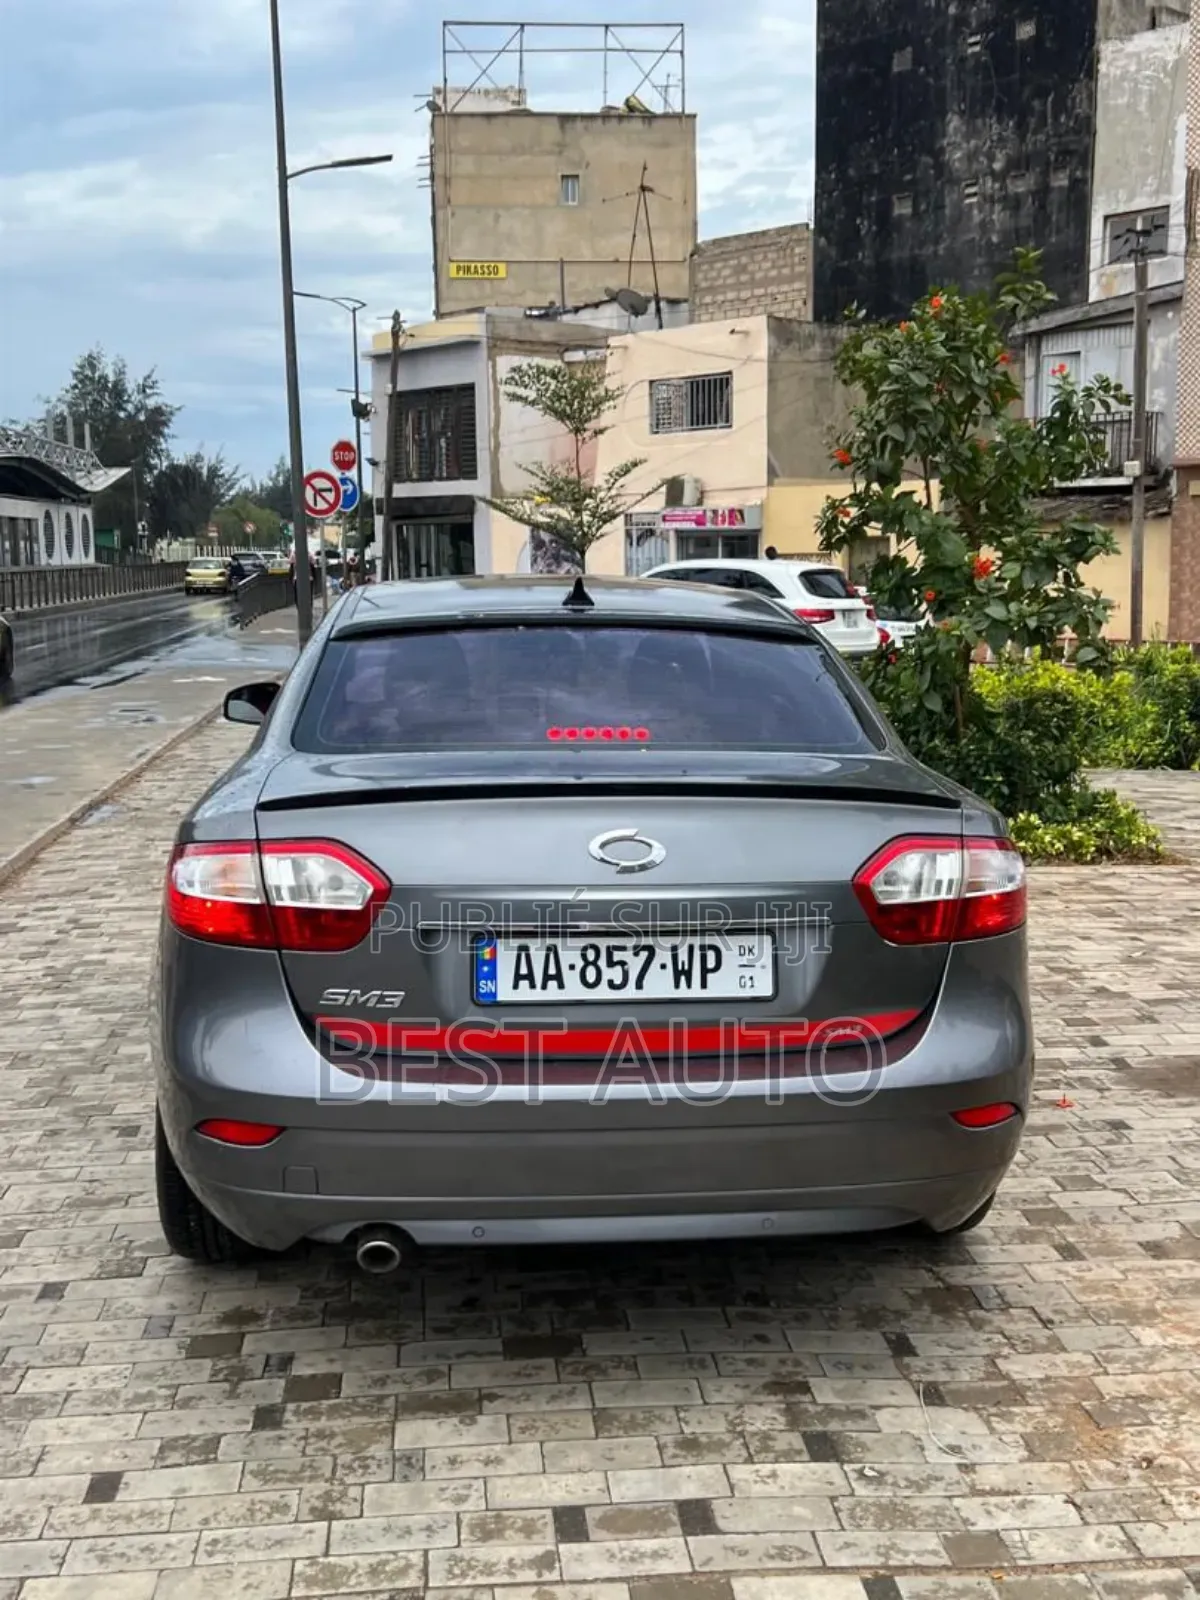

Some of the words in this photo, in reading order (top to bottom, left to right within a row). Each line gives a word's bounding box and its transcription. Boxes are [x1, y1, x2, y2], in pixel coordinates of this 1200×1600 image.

[455, 264, 499, 276] PIKASSO
[334, 451, 355, 461] STOP
[738, 944, 755, 957] DK
[479, 980, 496, 993] SN
[319, 988, 406, 1008] SM3
